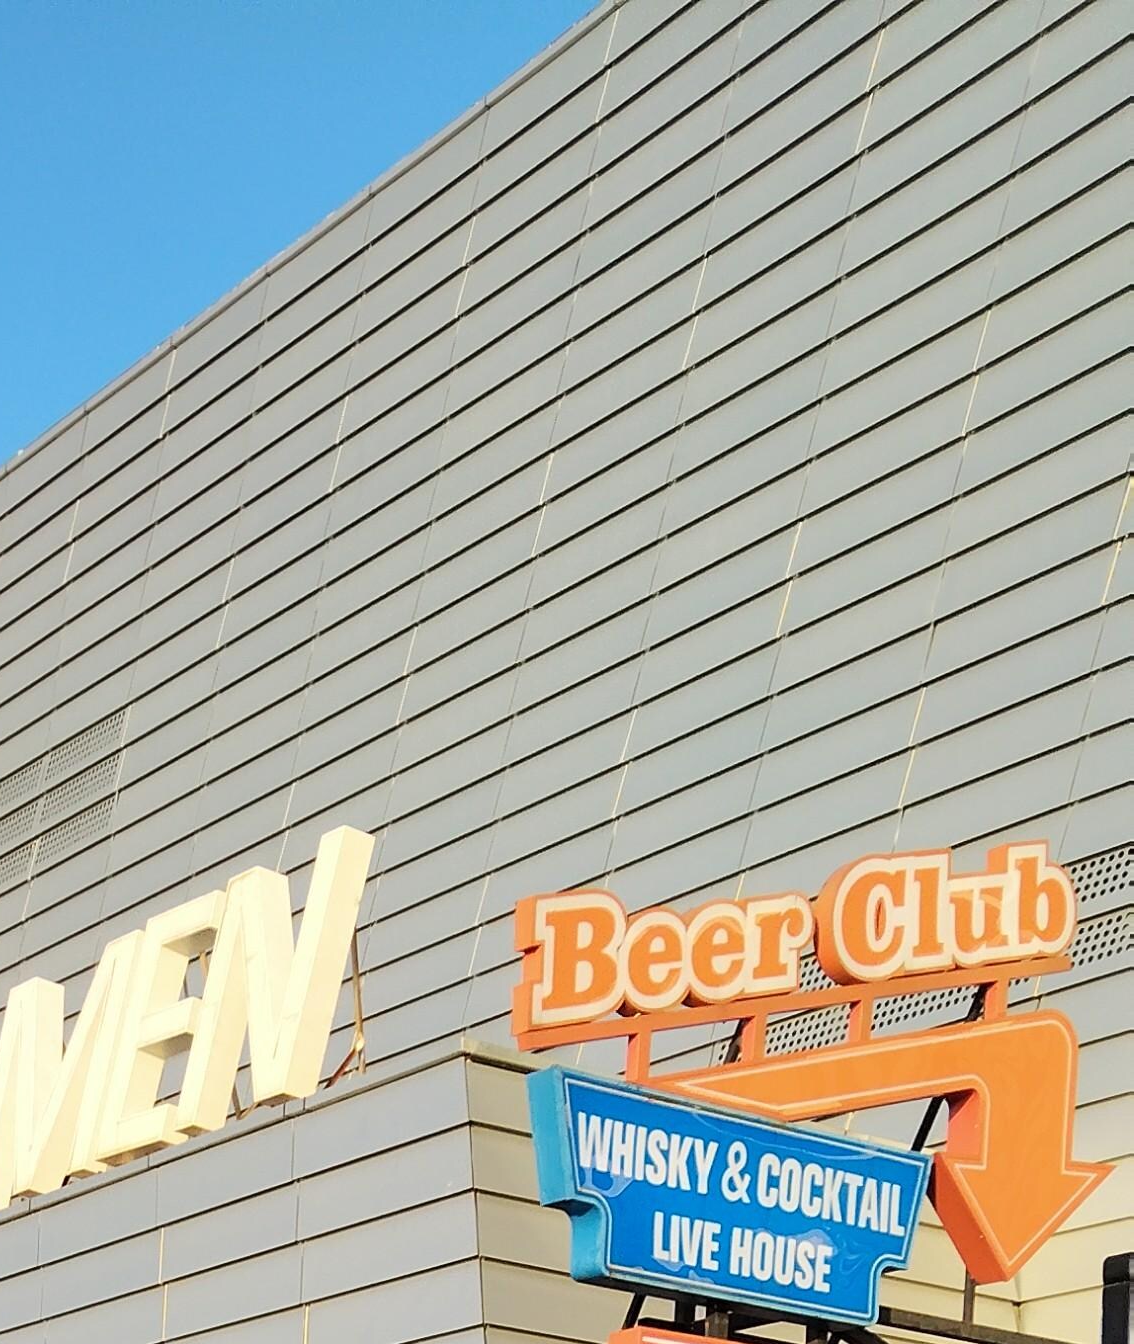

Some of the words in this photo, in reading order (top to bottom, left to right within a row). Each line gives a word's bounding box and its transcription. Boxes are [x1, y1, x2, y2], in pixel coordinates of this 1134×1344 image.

[531, 890, 813, 1024] Beer
[831, 843, 1078, 983] Club
[577, 1111, 717, 1196] WHISKY
[722, 1141, 752, 1203] &
[757, 1152, 906, 1237] COCKTAIL
[652, 1210, 721, 1273] LIVE
[730, 1227, 833, 1294] HOUSE
